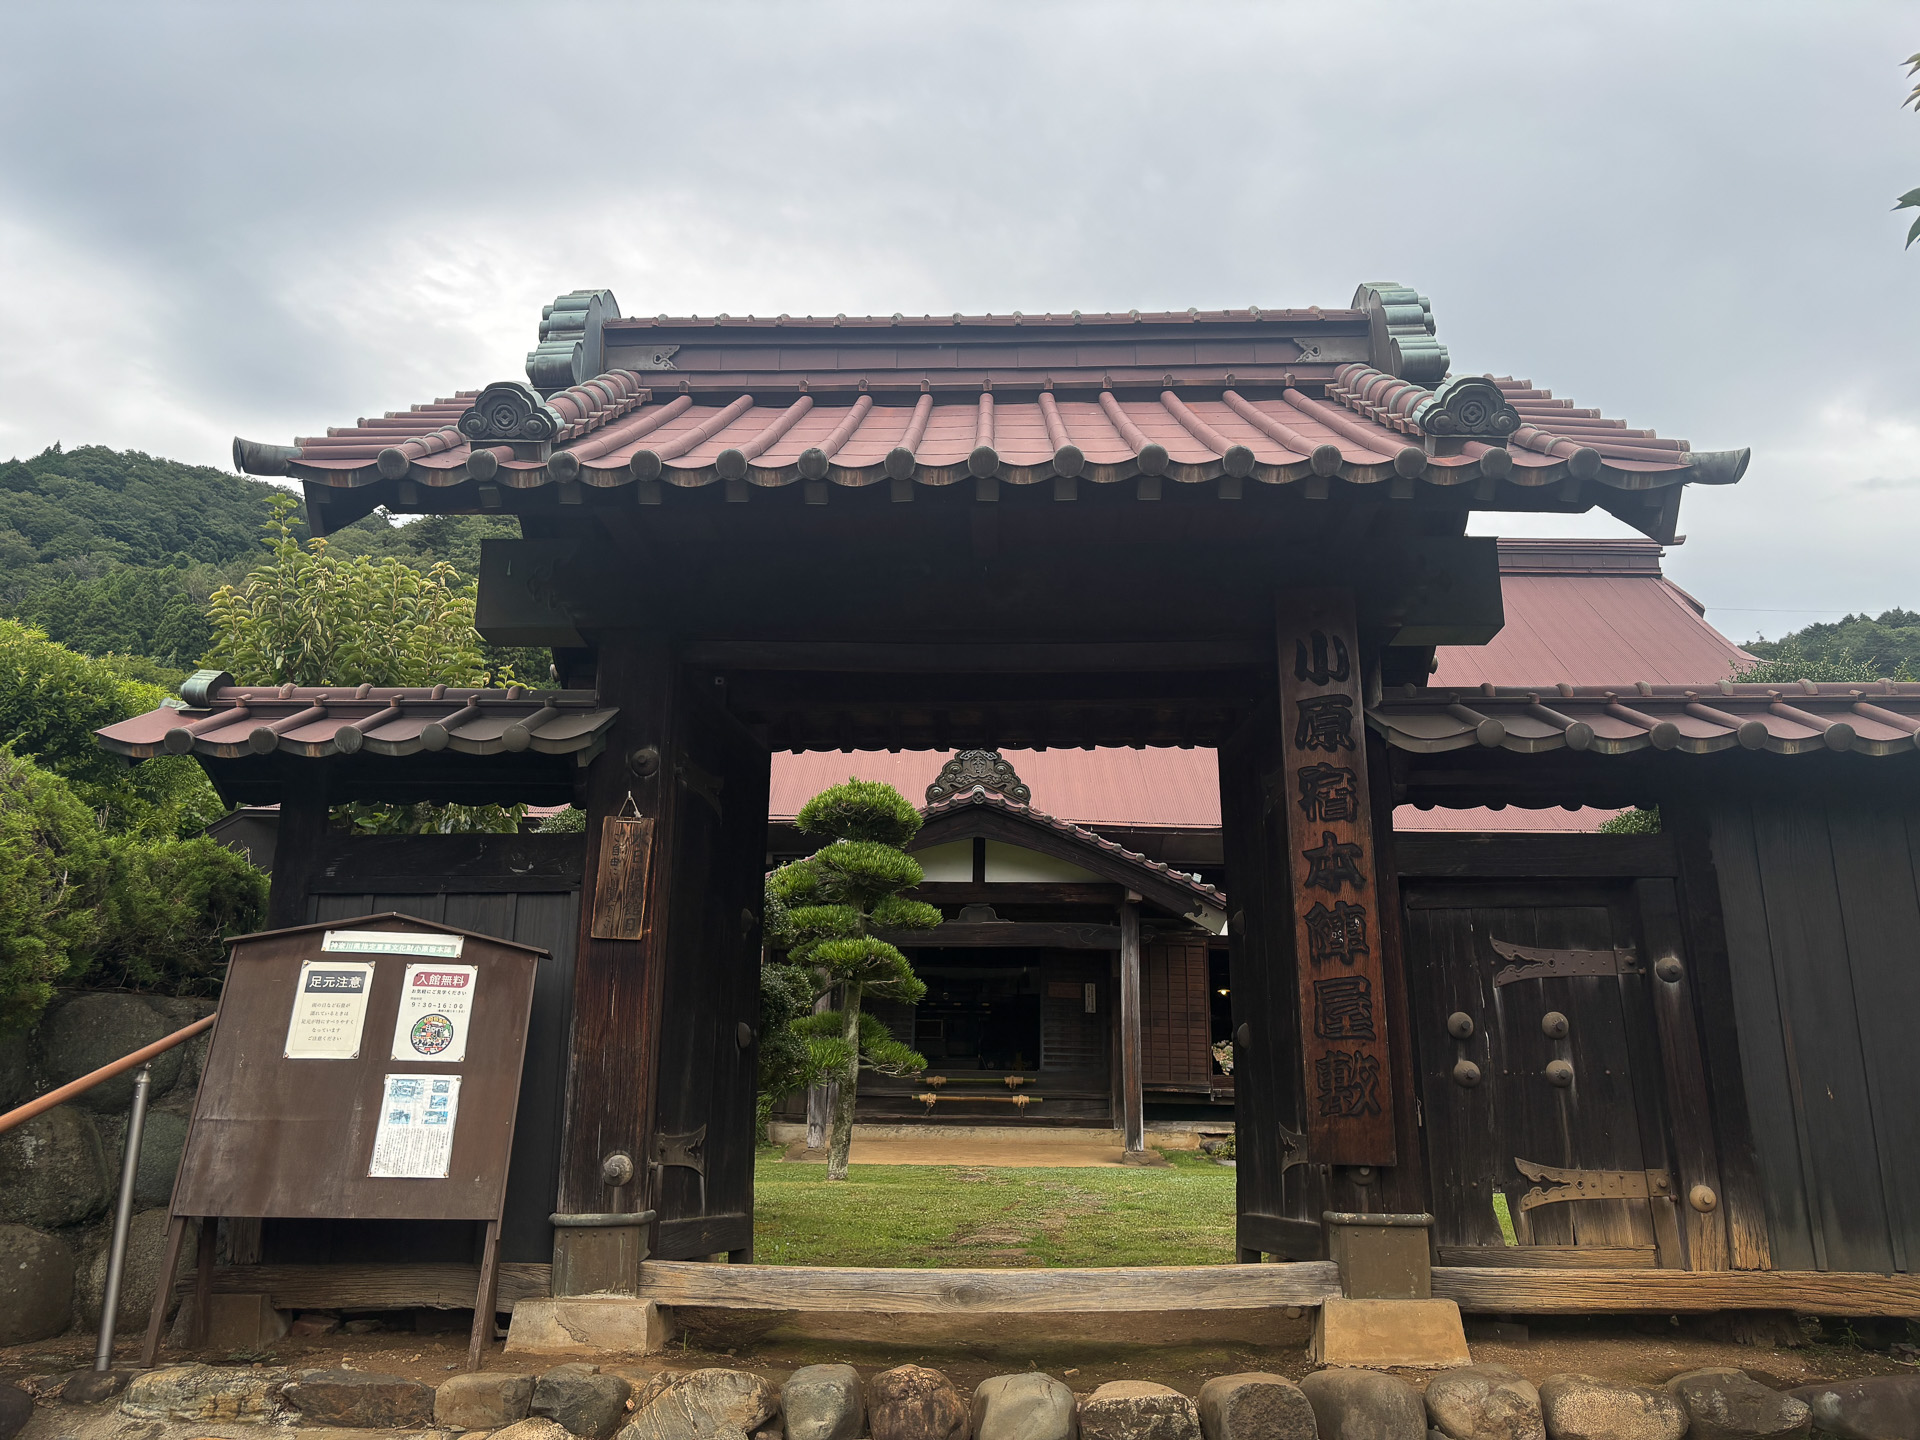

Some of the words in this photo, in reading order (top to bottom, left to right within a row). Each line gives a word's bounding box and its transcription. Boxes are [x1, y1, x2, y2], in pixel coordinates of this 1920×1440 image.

[309, 975, 362, 988] 足元注意
[416, 973, 464, 987] 入館無料
[411, 988, 467, 996] お気軽にご見学ください
